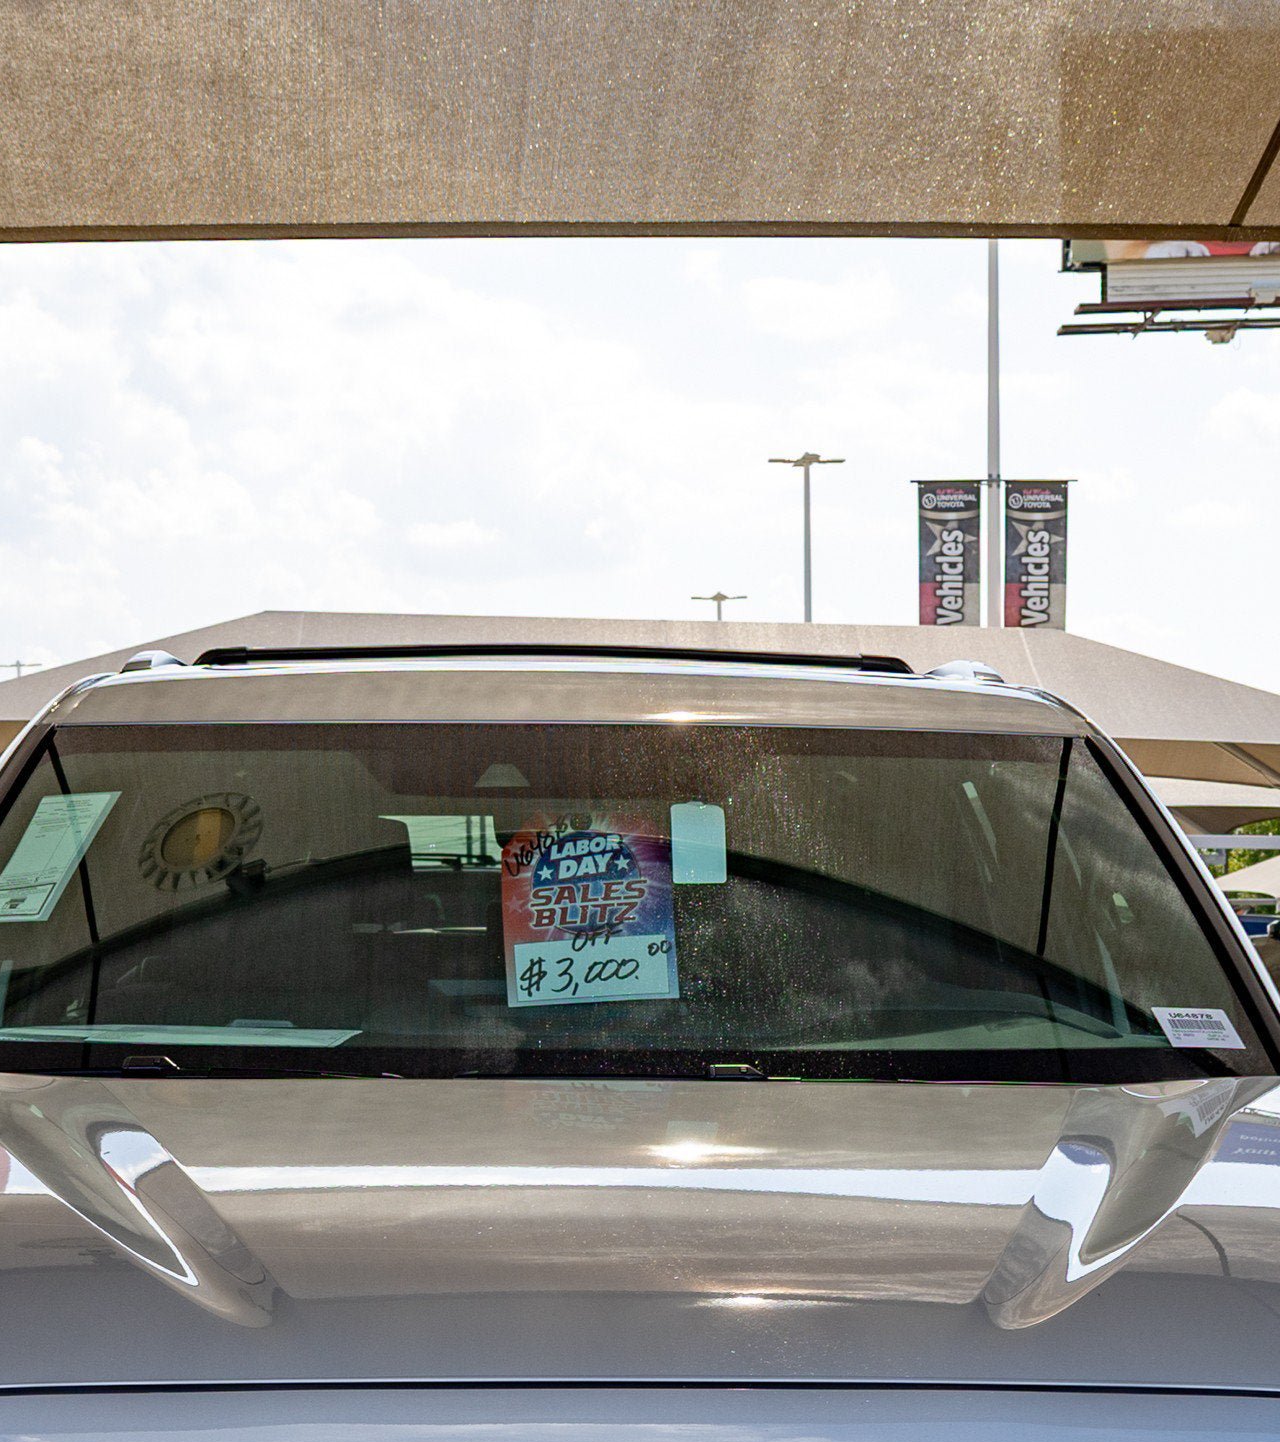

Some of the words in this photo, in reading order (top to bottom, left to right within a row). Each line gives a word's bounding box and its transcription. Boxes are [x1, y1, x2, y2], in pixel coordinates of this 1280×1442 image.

[935, 529, 965, 626] Vehicles
[1021, 530, 1051, 627] Vehicles
[550, 834, 622, 861] LABOR
[558, 853, 613, 880] DAY
[530, 879, 648, 908] SALES
[531, 902, 639, 930] BLITZ
